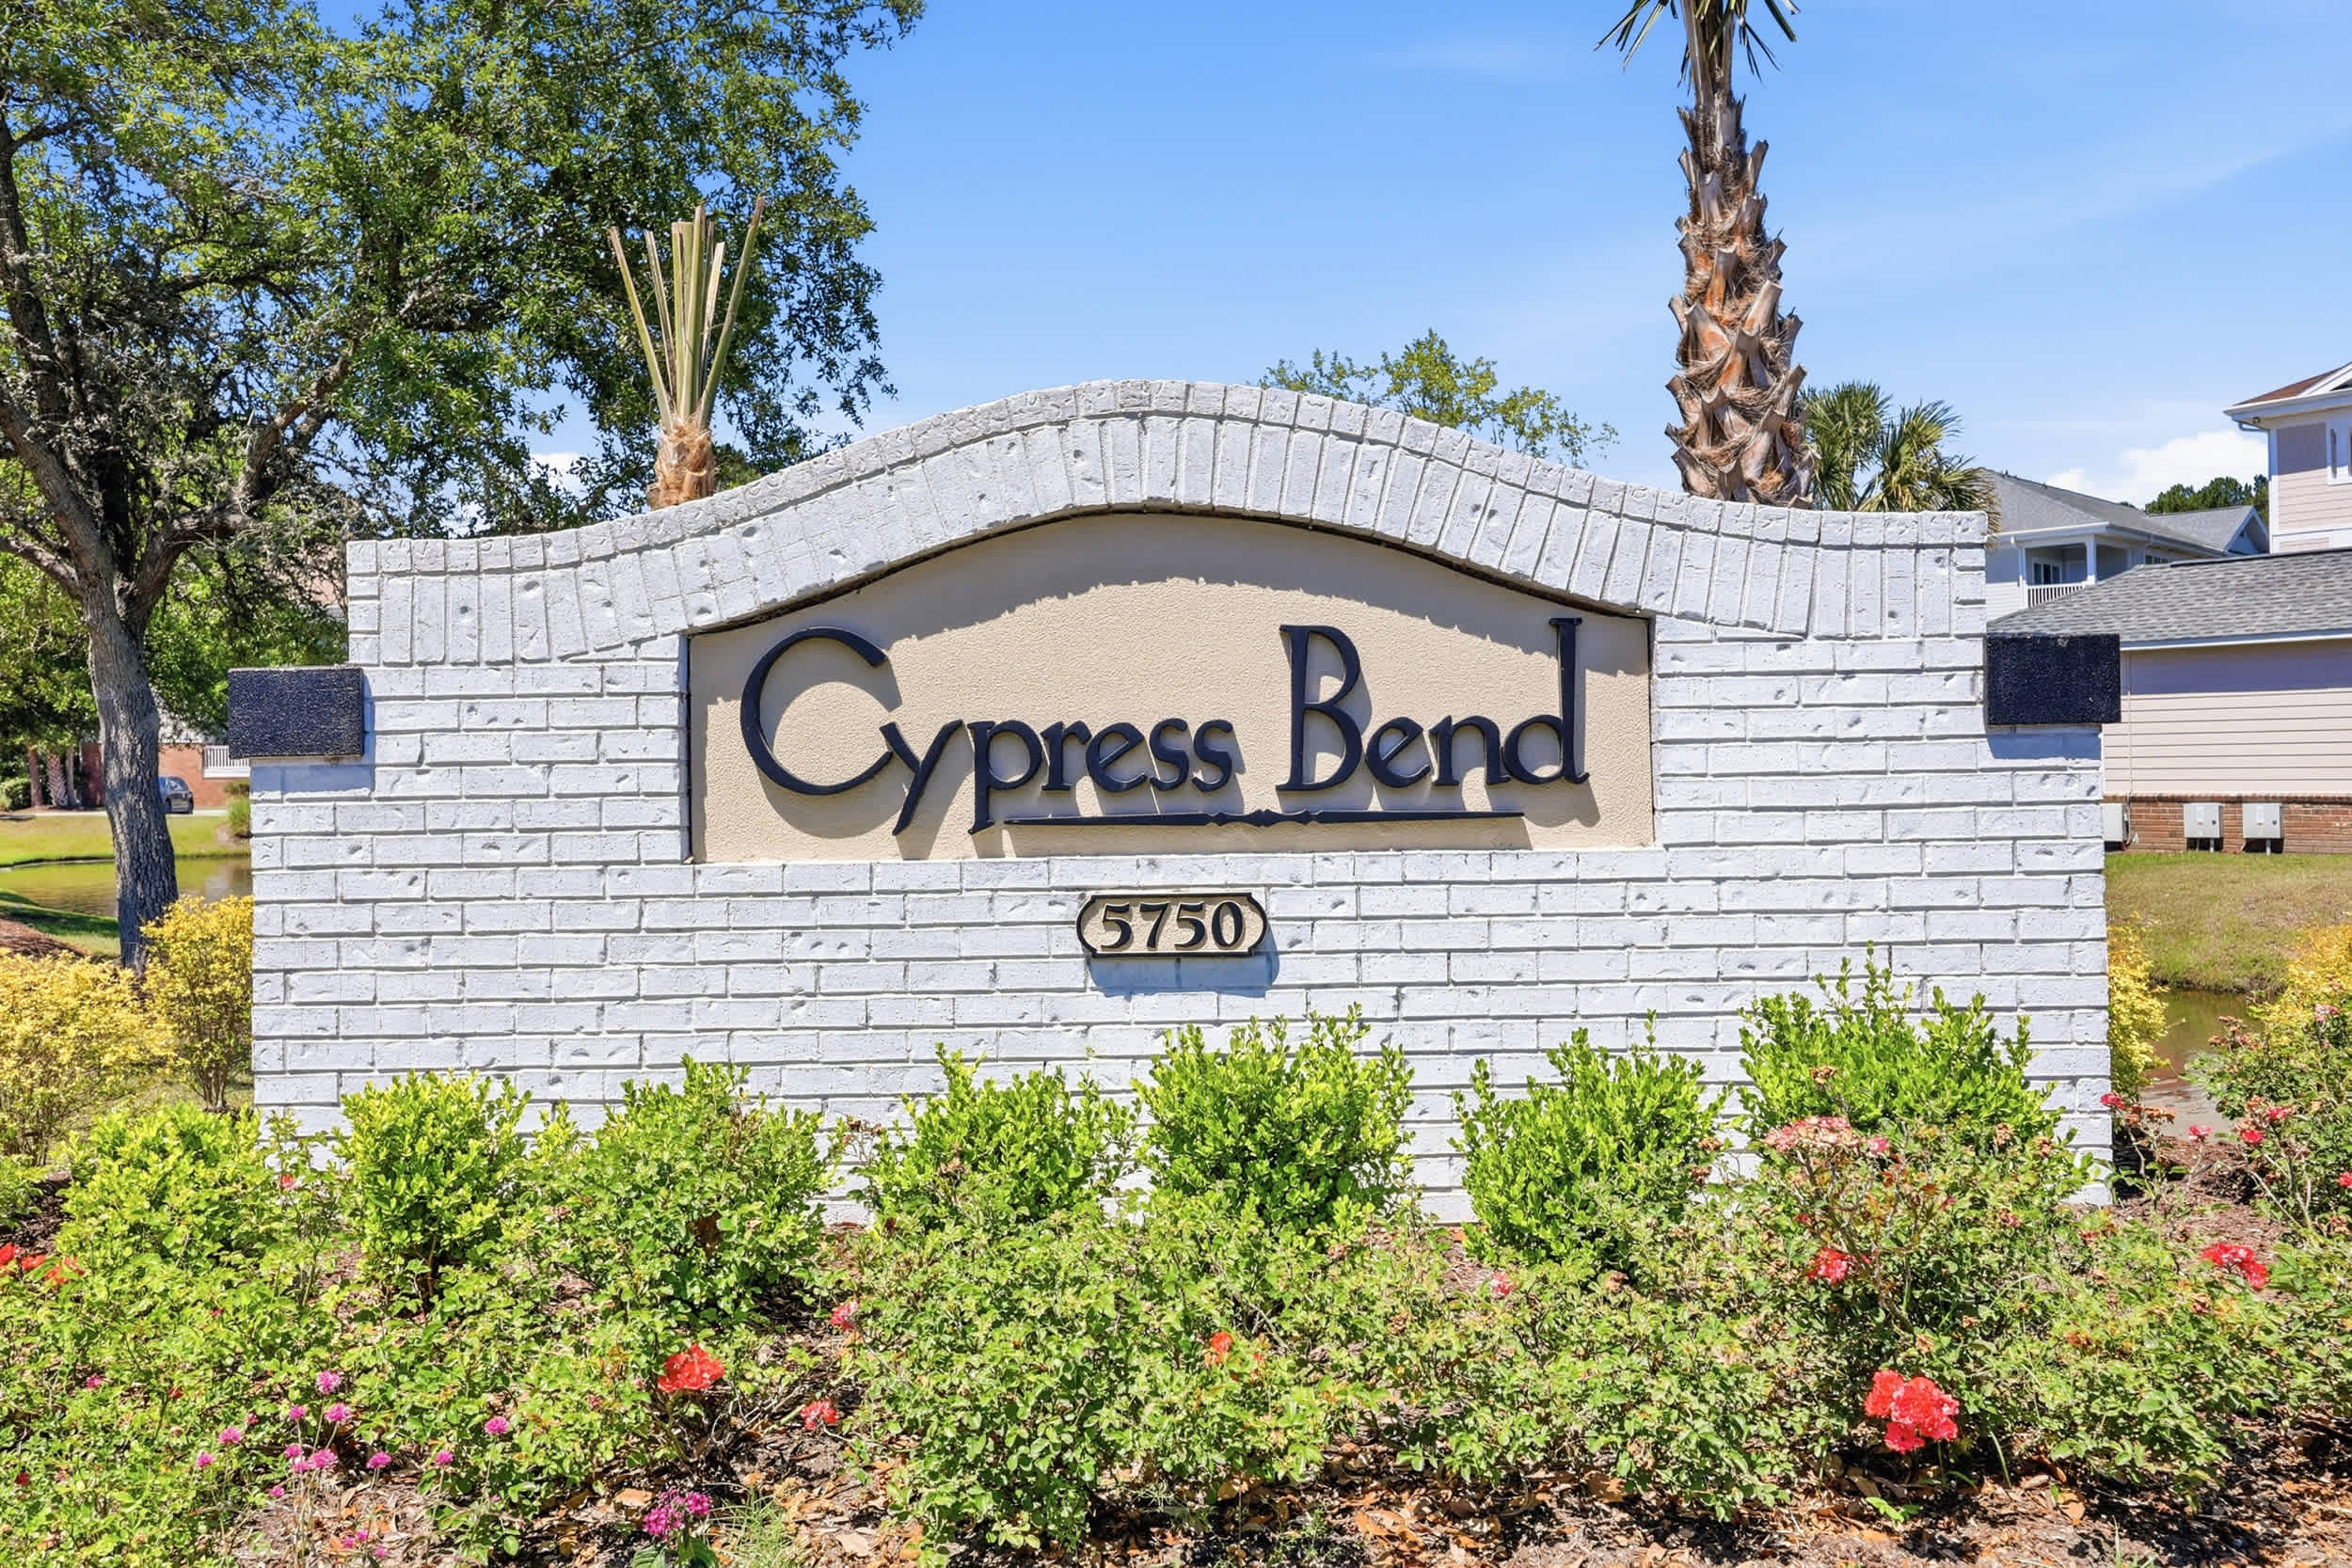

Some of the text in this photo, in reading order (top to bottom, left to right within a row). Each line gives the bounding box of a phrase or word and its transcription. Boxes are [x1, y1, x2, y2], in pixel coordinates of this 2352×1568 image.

[740, 617, 1589, 835] Cypress Bend
[1101, 900, 1244, 949] 5750
